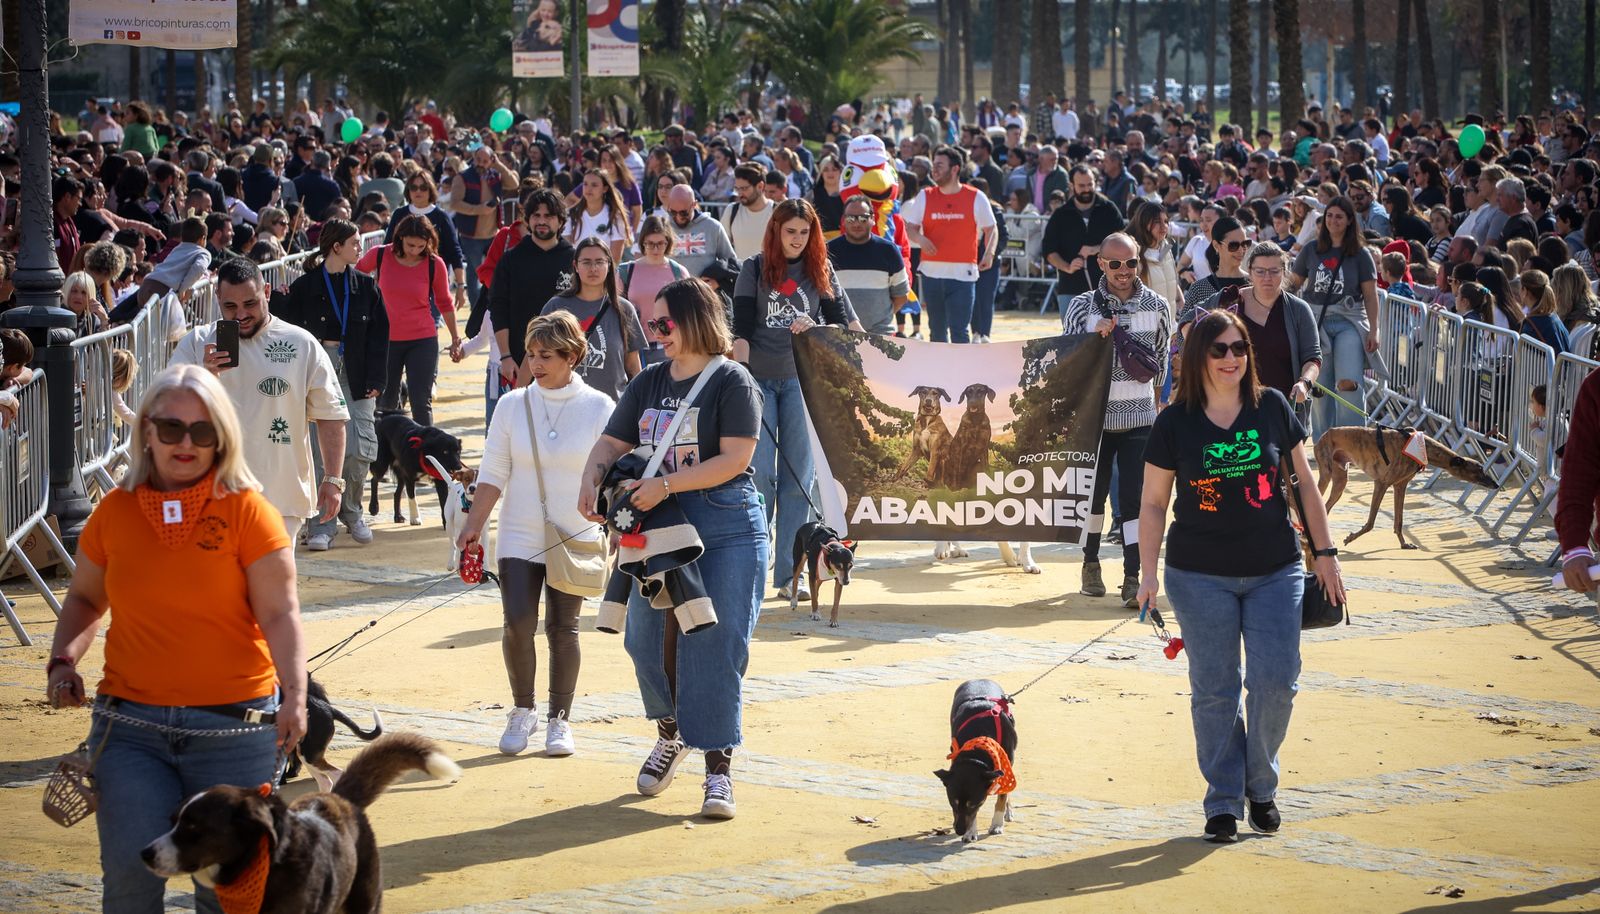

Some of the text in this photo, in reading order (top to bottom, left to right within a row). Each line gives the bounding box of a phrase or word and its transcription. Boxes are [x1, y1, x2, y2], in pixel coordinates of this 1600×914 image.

[104, 16, 230, 30] www.bricopinturas.com
[768, 289, 781, 301] ME
[768, 302, 780, 314] NO
[1018, 451, 1096, 465] PROTECTORA
[1208, 464, 1261, 475] VOLUNTARIADO
[976, 466, 1095, 496] NO ME
[850, 496, 1091, 528] ABANDONES
